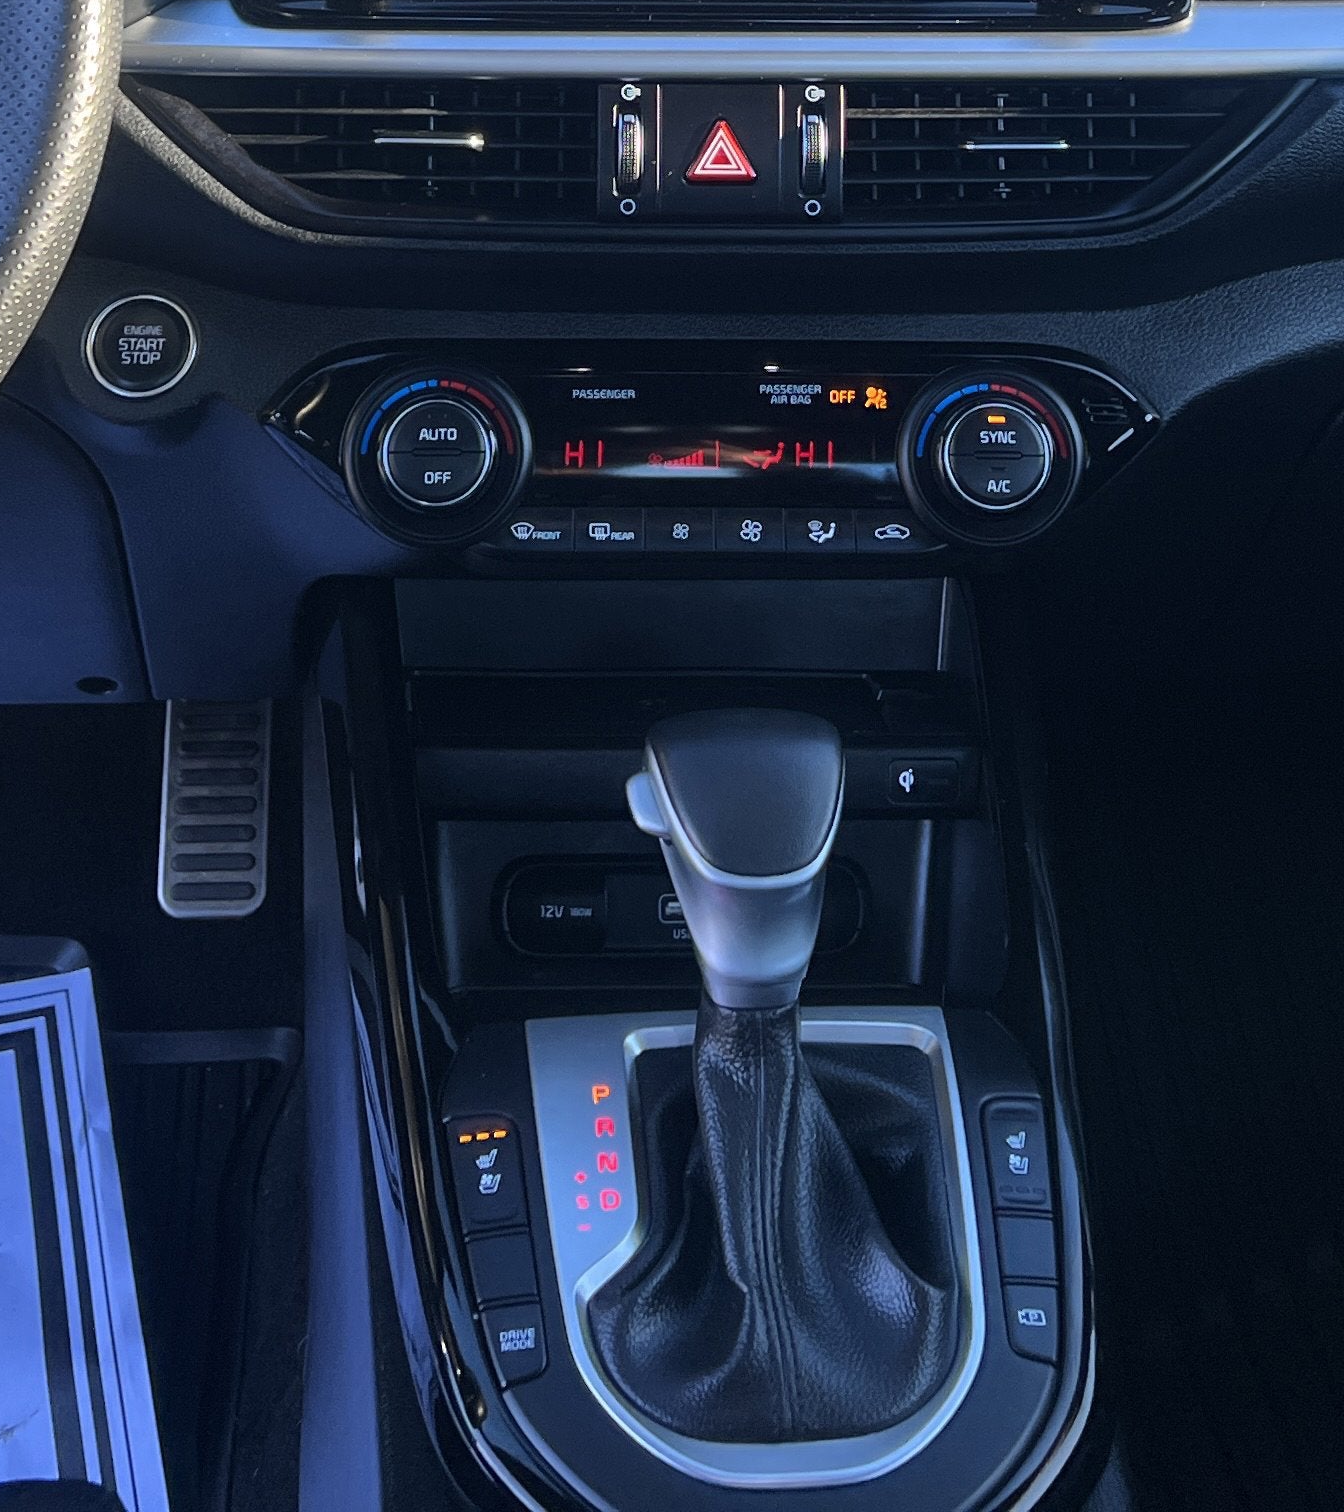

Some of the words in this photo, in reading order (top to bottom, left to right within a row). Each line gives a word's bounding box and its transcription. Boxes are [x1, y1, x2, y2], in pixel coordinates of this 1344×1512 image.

[123, 325, 163, 337] ENGINE
[118, 338, 166, 352] START
[121, 351, 161, 365] STOP
[572, 389, 636, 399] PASSENGER
[759, 384, 822, 395] PASSENGER
[770, 395, 788, 405] AIR
[790, 395, 812, 405] BAG
[829, 390, 856, 404] OFF
[419, 428, 458, 441] AUTO
[979, 430, 1017, 444] SYNC
[424, 471, 452, 485] OFF
[987, 479, 1011, 494] A/C
[540, 905, 564, 918] 12V
[591, 1083, 611, 1104] P
[597, 1151, 619, 1173] N
[575, 1194, 590, 1210] S
[599, 1188, 622, 1212] D
[499, 1327, 536, 1342] DRIVE
[500, 1338, 536, 1352] MODE
